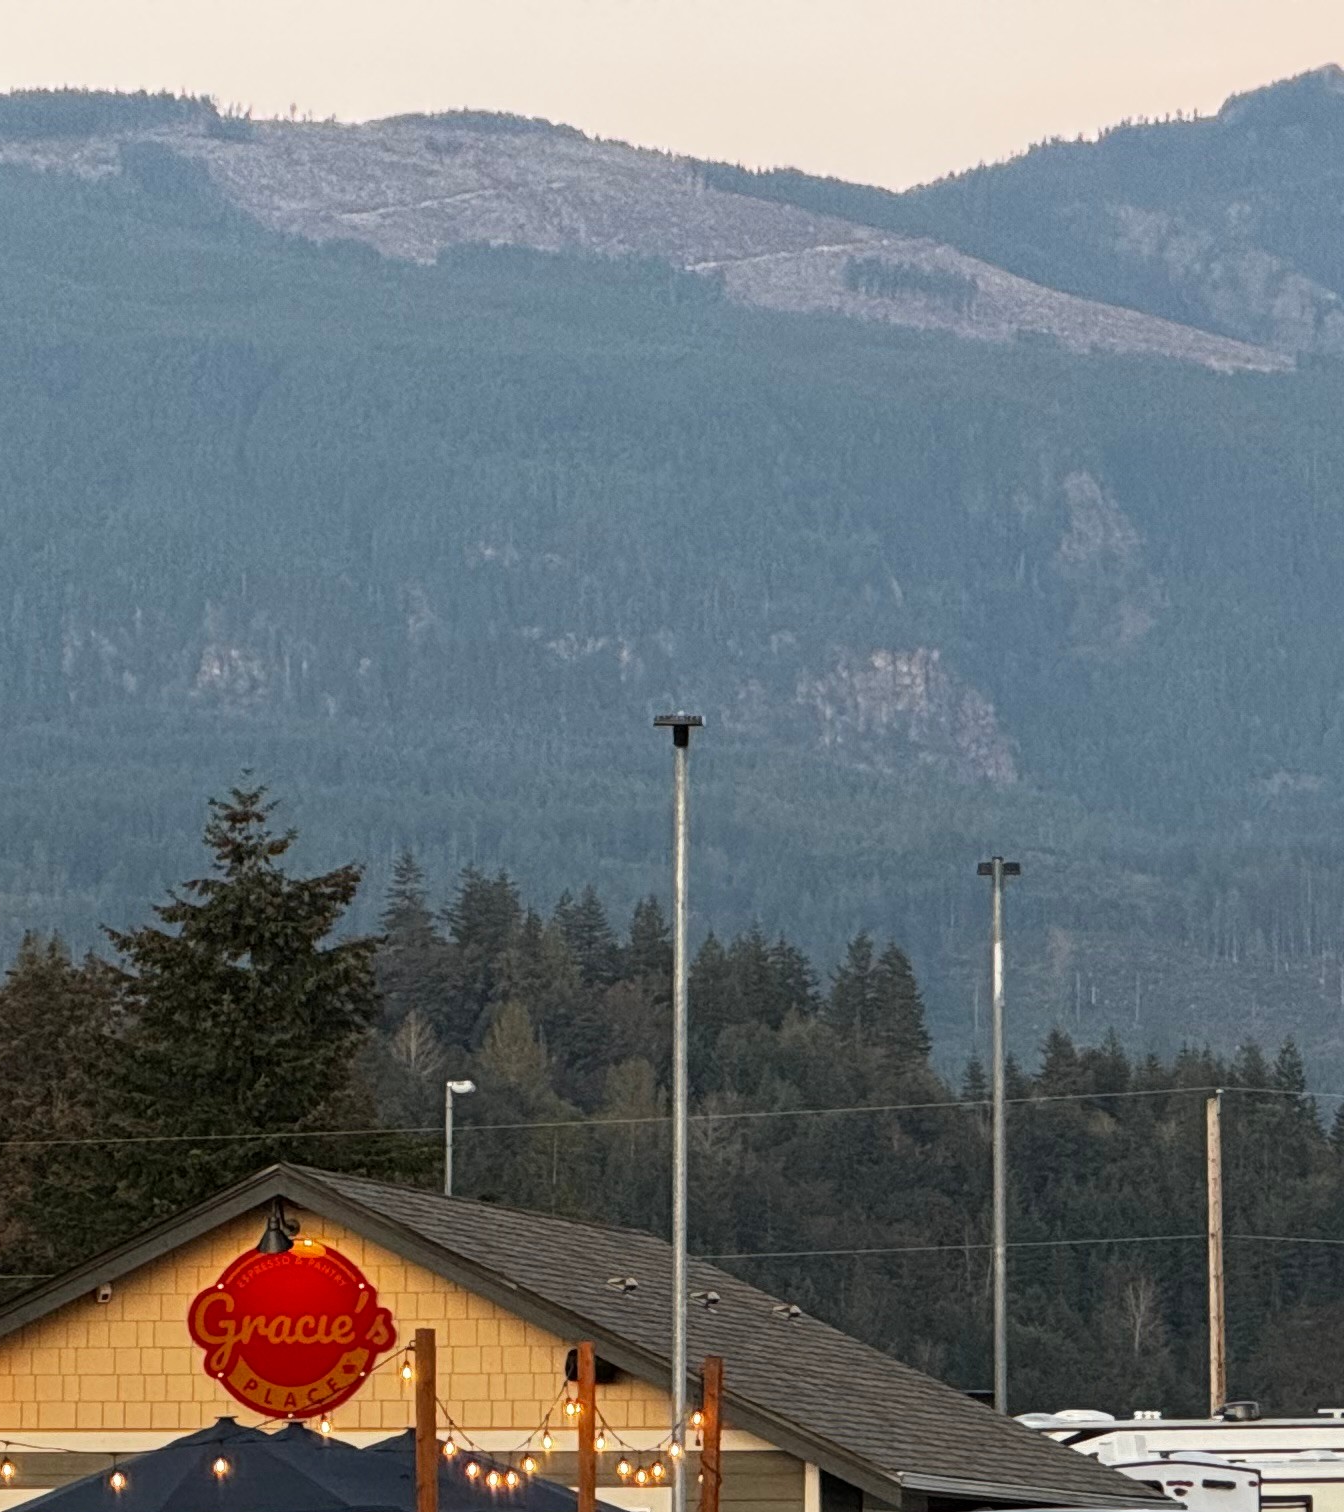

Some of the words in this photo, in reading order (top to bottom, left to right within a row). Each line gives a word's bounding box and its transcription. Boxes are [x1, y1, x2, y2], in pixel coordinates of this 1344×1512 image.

[237, 1256, 291, 1288] ESPRESSO
[295, 1256, 303, 1265] &
[308, 1257, 348, 1287] PANTRY
[194, 1290, 390, 1371] Gracie's
[243, 1377, 344, 1408] PLACE
